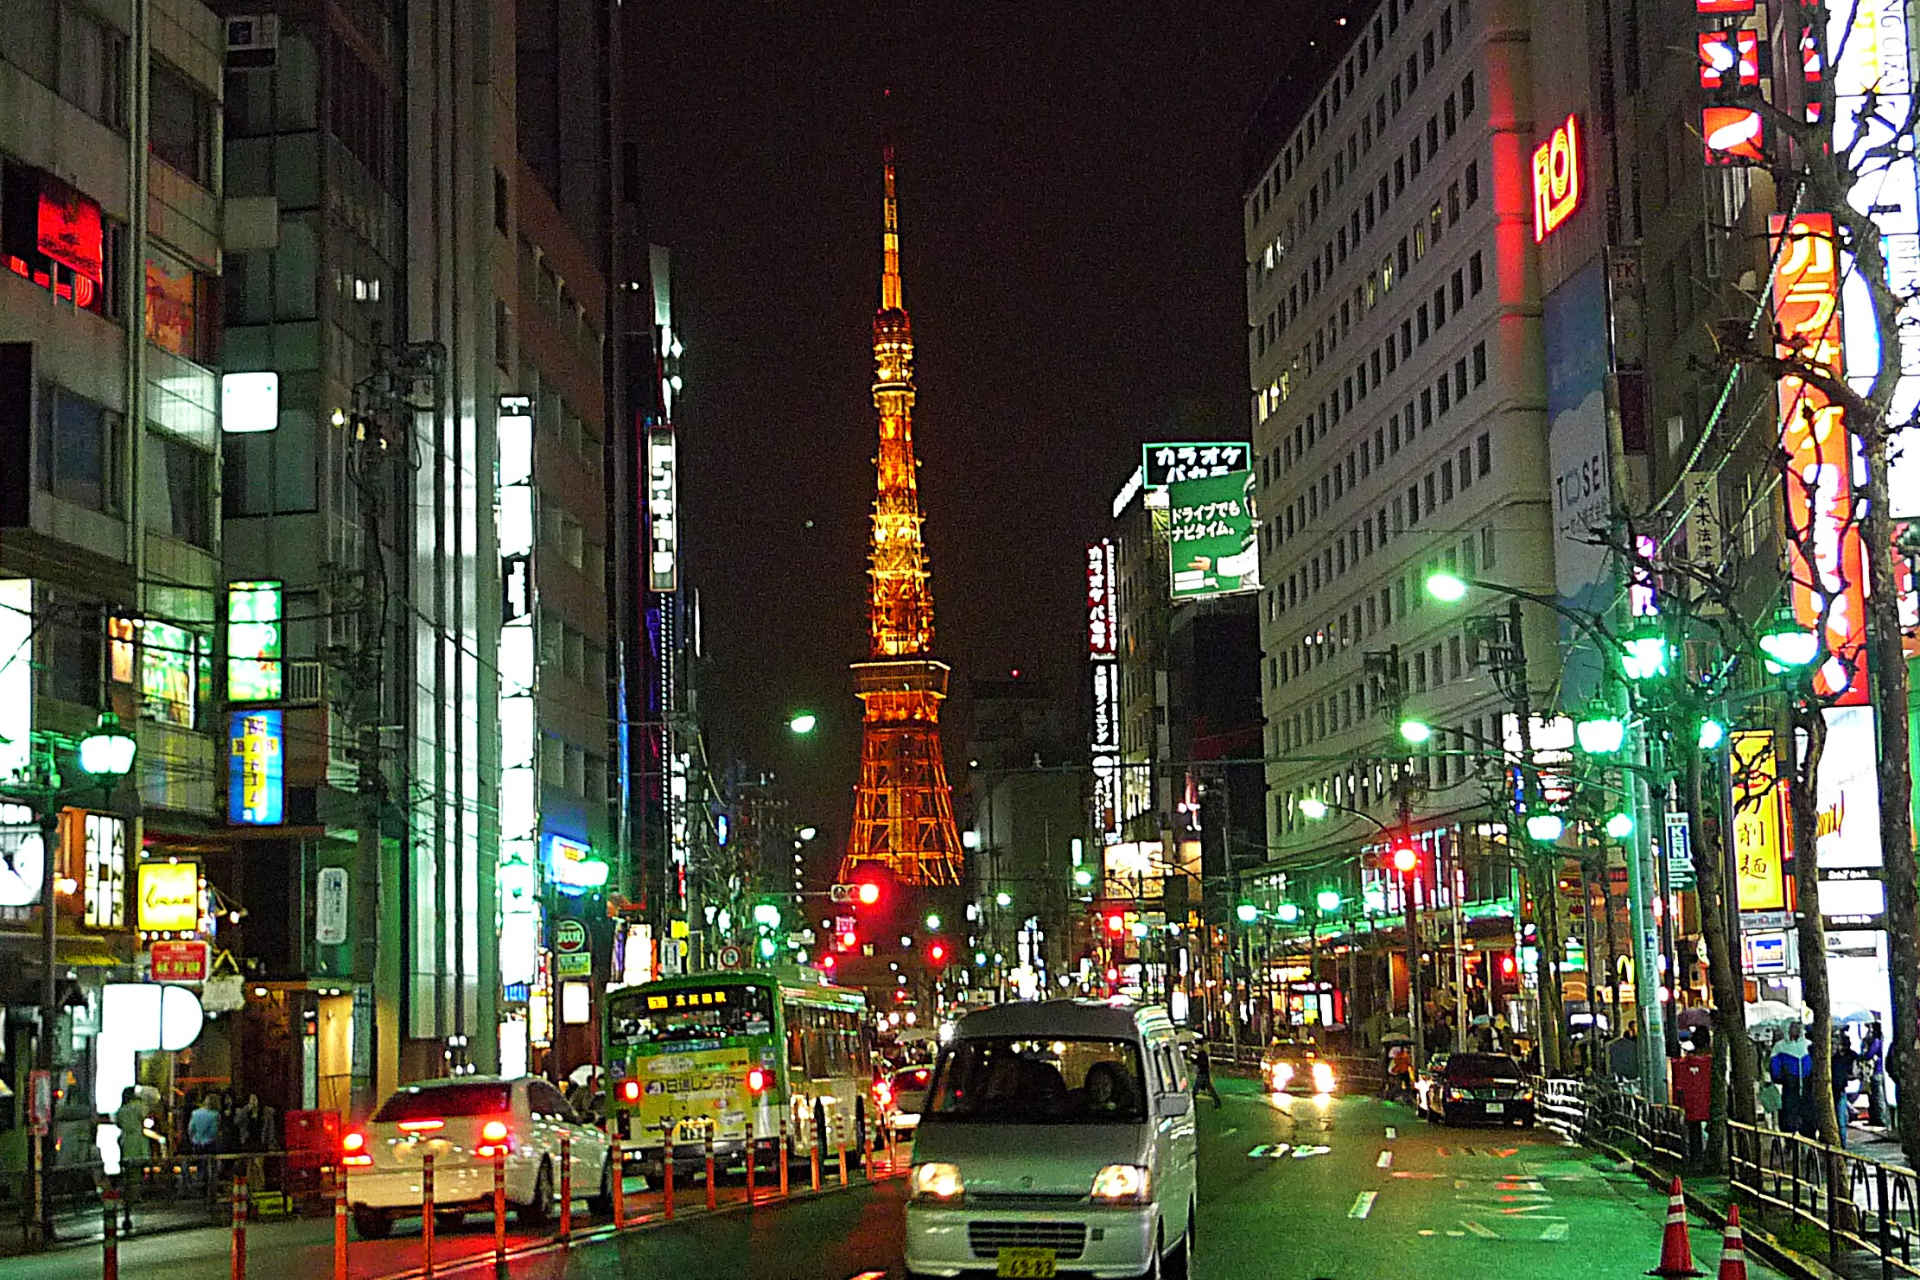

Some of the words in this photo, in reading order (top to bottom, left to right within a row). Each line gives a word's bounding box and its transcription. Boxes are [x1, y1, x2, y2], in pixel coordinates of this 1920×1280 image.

[1156, 447, 1241, 466] カラオケ
[1172, 500, 1240, 524] ドライブでも
[1671, 826, 1685, 858] KEN
